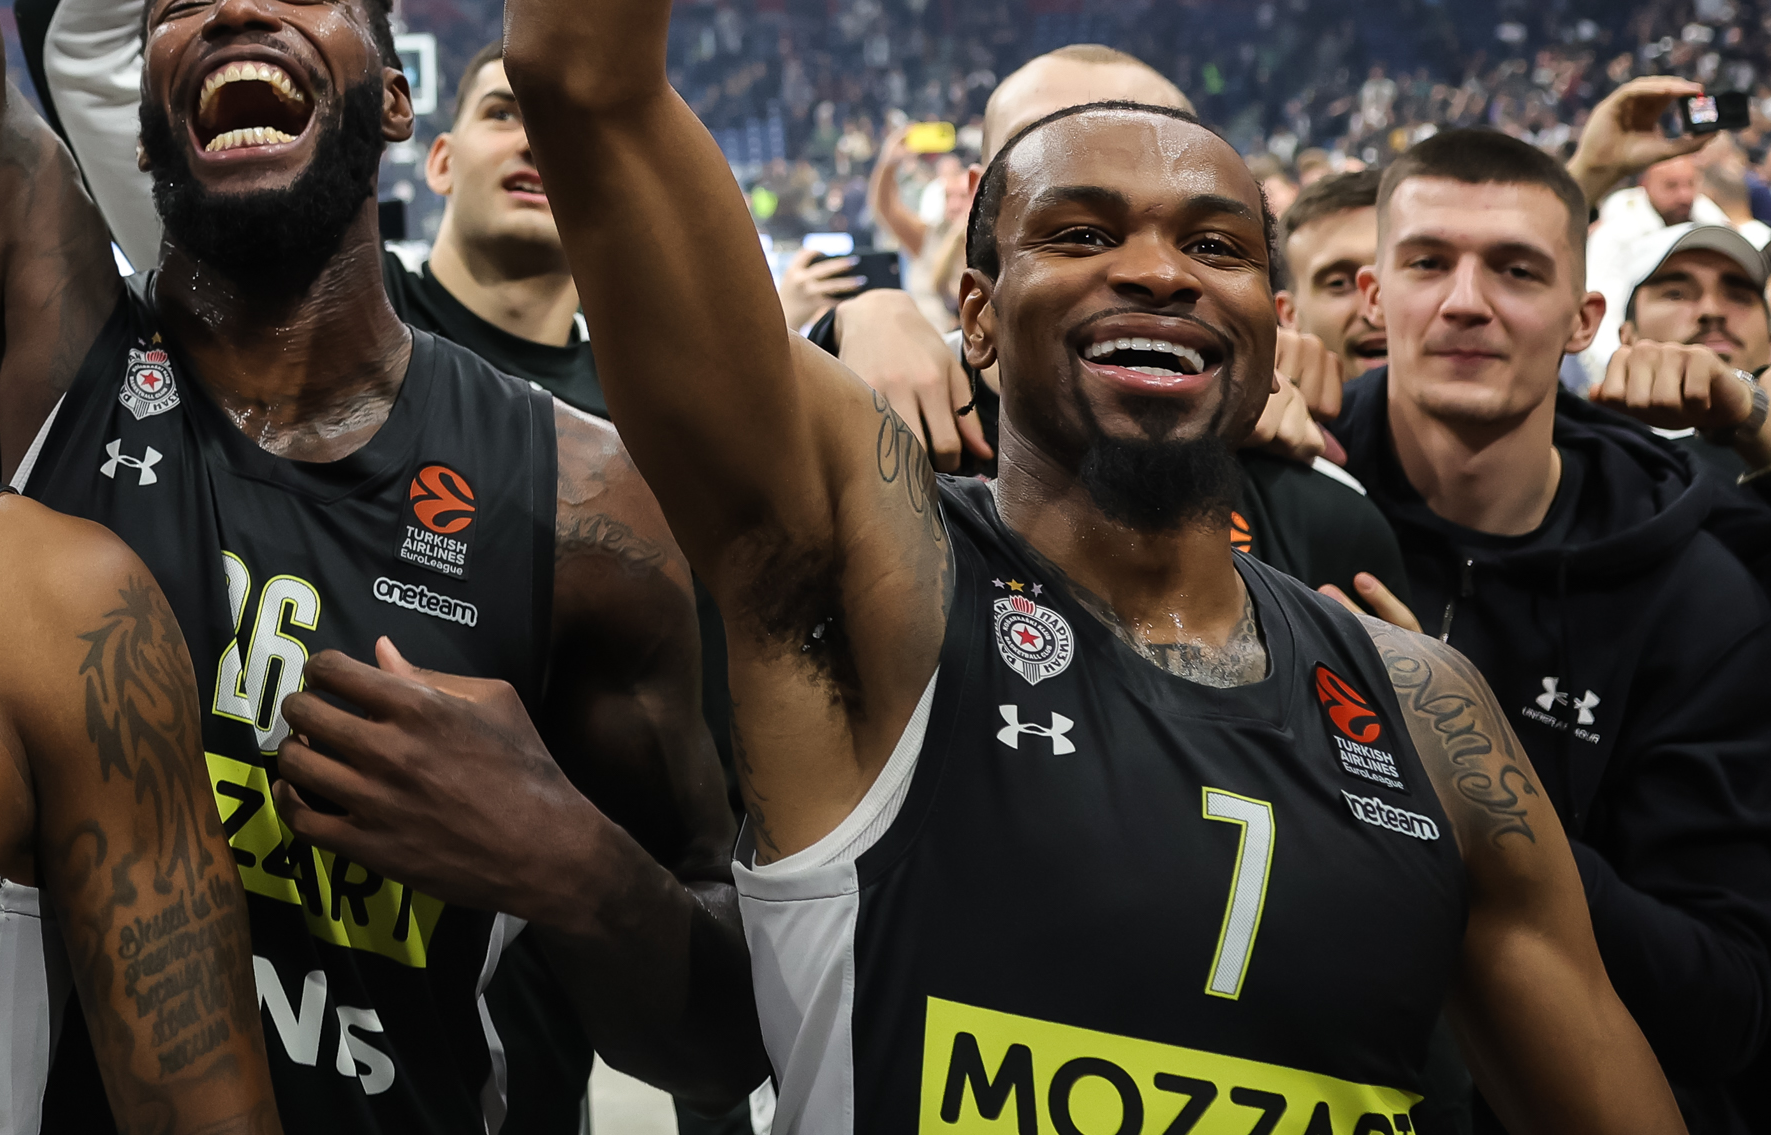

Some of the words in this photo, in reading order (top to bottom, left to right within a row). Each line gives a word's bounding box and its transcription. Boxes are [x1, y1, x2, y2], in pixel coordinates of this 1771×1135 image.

[402, 537, 465, 565] AIRLINES
[406, 525, 467, 555] TURKISH
[400, 548, 463, 576] EuroLeague
[374, 577, 478, 627] oneteam
[212, 550, 322, 756] 26
[1039, 611, 1070, 674] ПАРТИЗАН
[1333, 734, 1395, 766] TURKISH
[1340, 749, 1400, 778] AIRLINES
[1342, 761, 1405, 790] EuroLeague
[1342, 792, 1440, 840] neteam
[1201, 786, 1276, 1001] 7
[940, 1031, 1413, 1135] MOZZ
